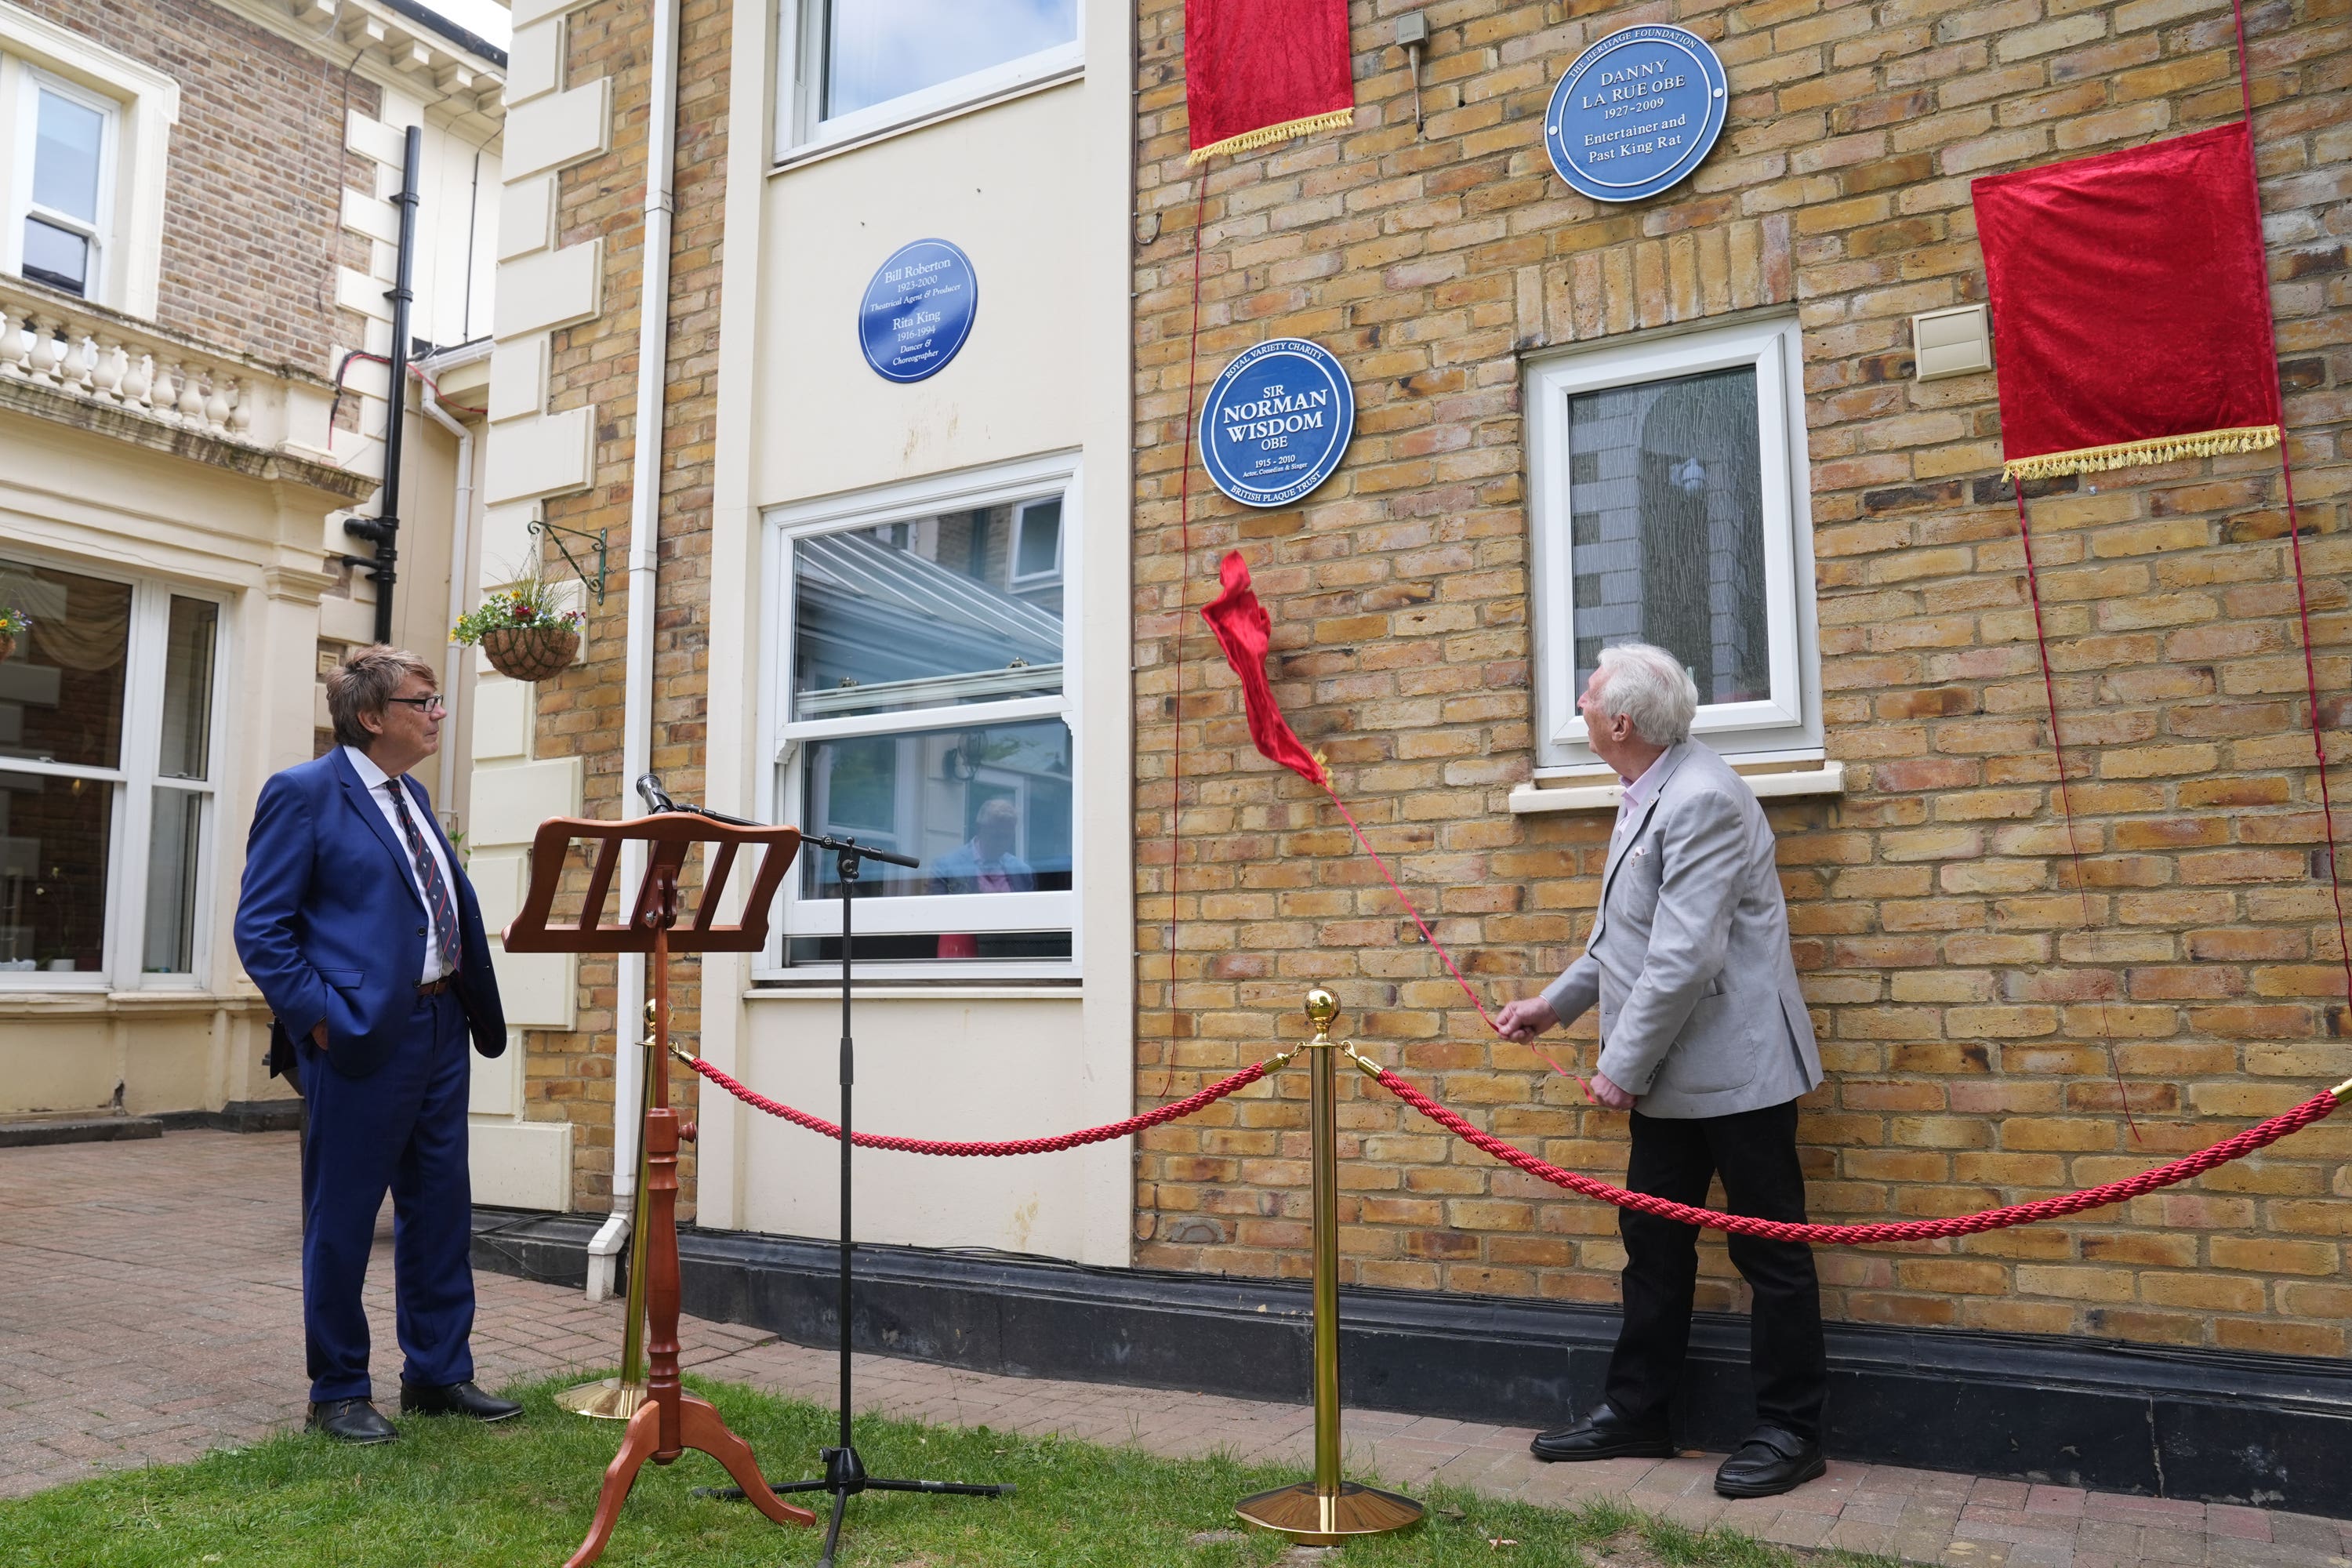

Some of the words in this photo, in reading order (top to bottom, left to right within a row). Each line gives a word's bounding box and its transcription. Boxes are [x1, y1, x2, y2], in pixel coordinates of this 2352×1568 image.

[1569, 62, 1586, 78] THE
[1585, 33, 1632, 62] HERITAGE
[1635, 30, 1697, 49] FOUNDATION
[1601, 60, 1668, 86] DANNY
[1582, 93, 1606, 109] LA
[1612, 82, 1648, 102] RUE
[1652, 75, 1686, 93] OBE
[1605, 98, 1664, 119] 1927-2009
[1584, 122, 1658, 147] Entertainer
[1661, 114, 1686, 129] and
[1589, 148, 1615, 163] Past
[1621, 142, 1653, 157] King
[1657, 135, 1681, 148] Rat
[884, 269, 902, 283] Bill
[905, 260, 951, 278] Roberton
[898, 275, 937, 292] 1923-2000
[871, 297, 902, 311] Theatrical
[904, 293, 922, 303] Agent
[932, 285, 961, 296] Producer
[893, 318, 913, 330] Rita
[916, 311, 941, 324] King
[898, 325, 935, 341] 1916-1994
[893, 350, 938, 365] Choreographer
[901, 343, 924, 353] Dancer
[1225, 357, 1250, 379] ROYAL
[1250, 343, 1287, 358] VARIETY
[1288, 343, 1324, 361] CHARITY
[1263, 385, 1285, 398] SIR
[1223, 389, 1327, 423] NORMAN
[1226, 411, 1323, 443] WISDOM
[1261, 436, 1288, 451] OBE
[1255, 459, 1271, 468] 1915
[1279, 455, 1295, 464] 2010
[1230, 485, 1261, 501] BRITISH
[1262, 489, 1296, 502] PLAQUE
[1296, 471, 1321, 492] TRUST
